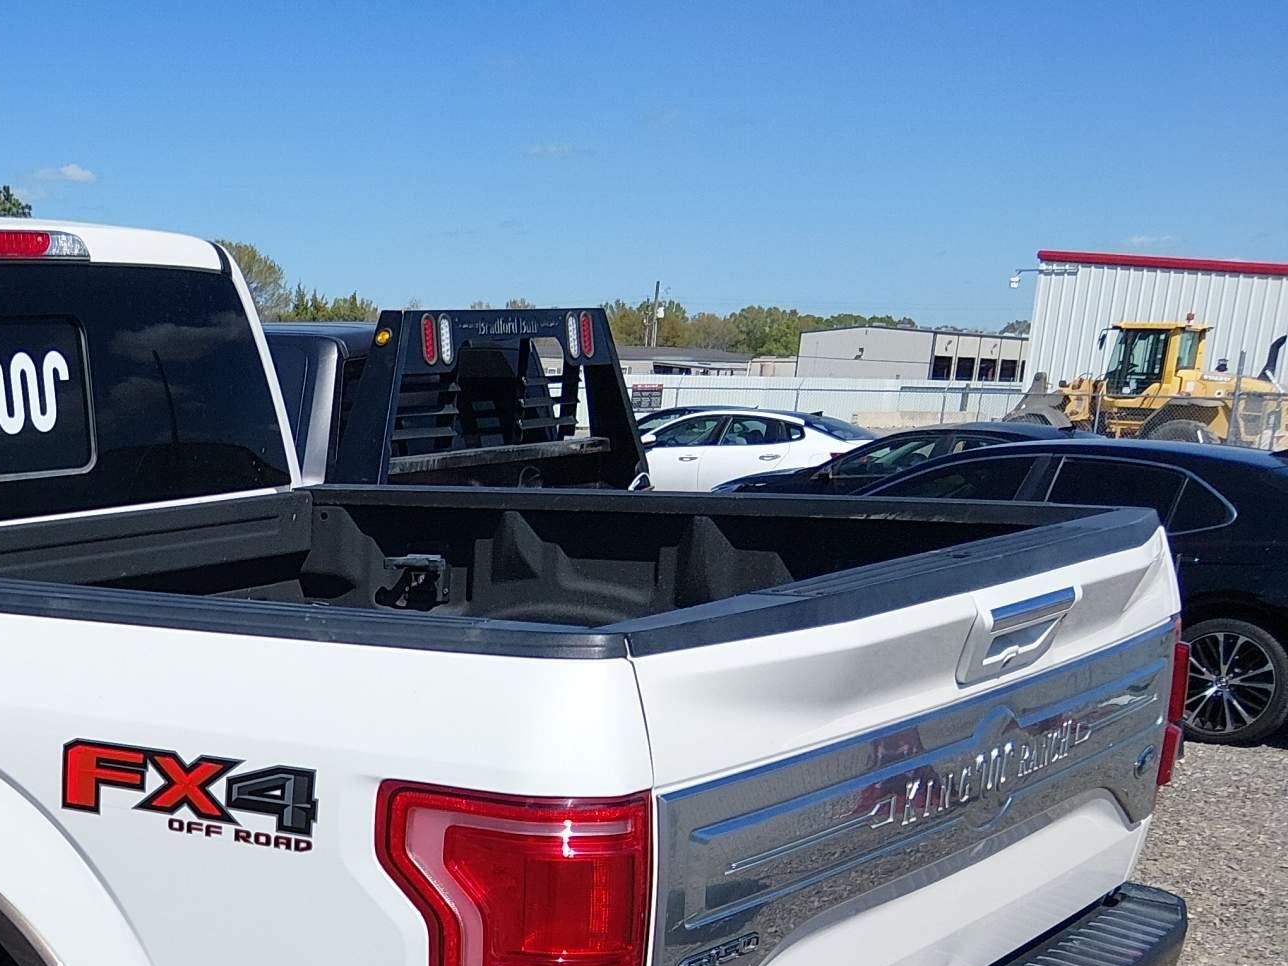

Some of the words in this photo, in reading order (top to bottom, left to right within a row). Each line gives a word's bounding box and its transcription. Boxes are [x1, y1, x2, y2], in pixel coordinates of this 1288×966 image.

[61, 738, 319, 837] FX4
[901, 767, 970, 826] KING
[1017, 719, 1073, 777] RANCH
[167, 817, 223, 838] OFF
[233, 828, 313, 853] ROAD
